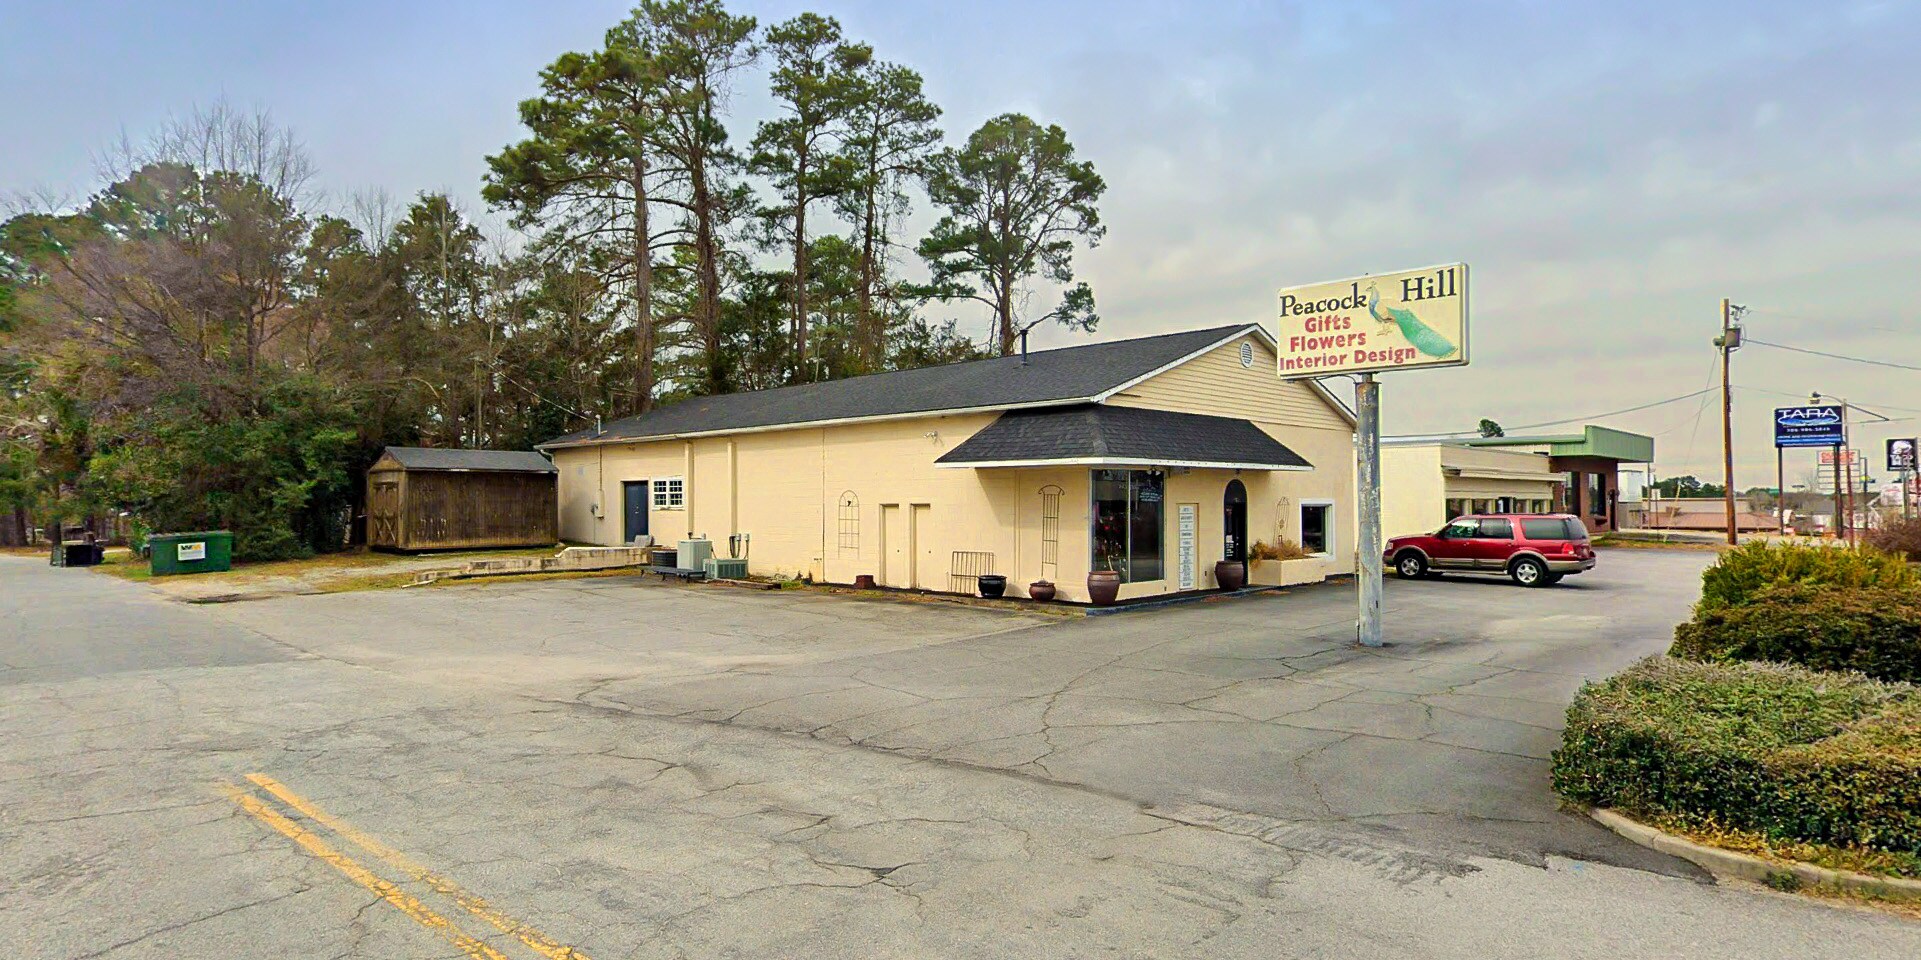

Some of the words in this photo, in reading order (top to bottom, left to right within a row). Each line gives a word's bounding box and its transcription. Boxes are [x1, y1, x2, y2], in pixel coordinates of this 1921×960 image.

[1279, 282, 1367, 317] Peacock
[1400, 268, 1457, 302] Hill
[1304, 315, 1352, 333] Gifts
[1290, 332, 1367, 352] Flowers
[1280, 352, 1347, 371] Interior
[1354, 347, 1416, 364] Design
[1778, 408, 1837, 418] TARA
